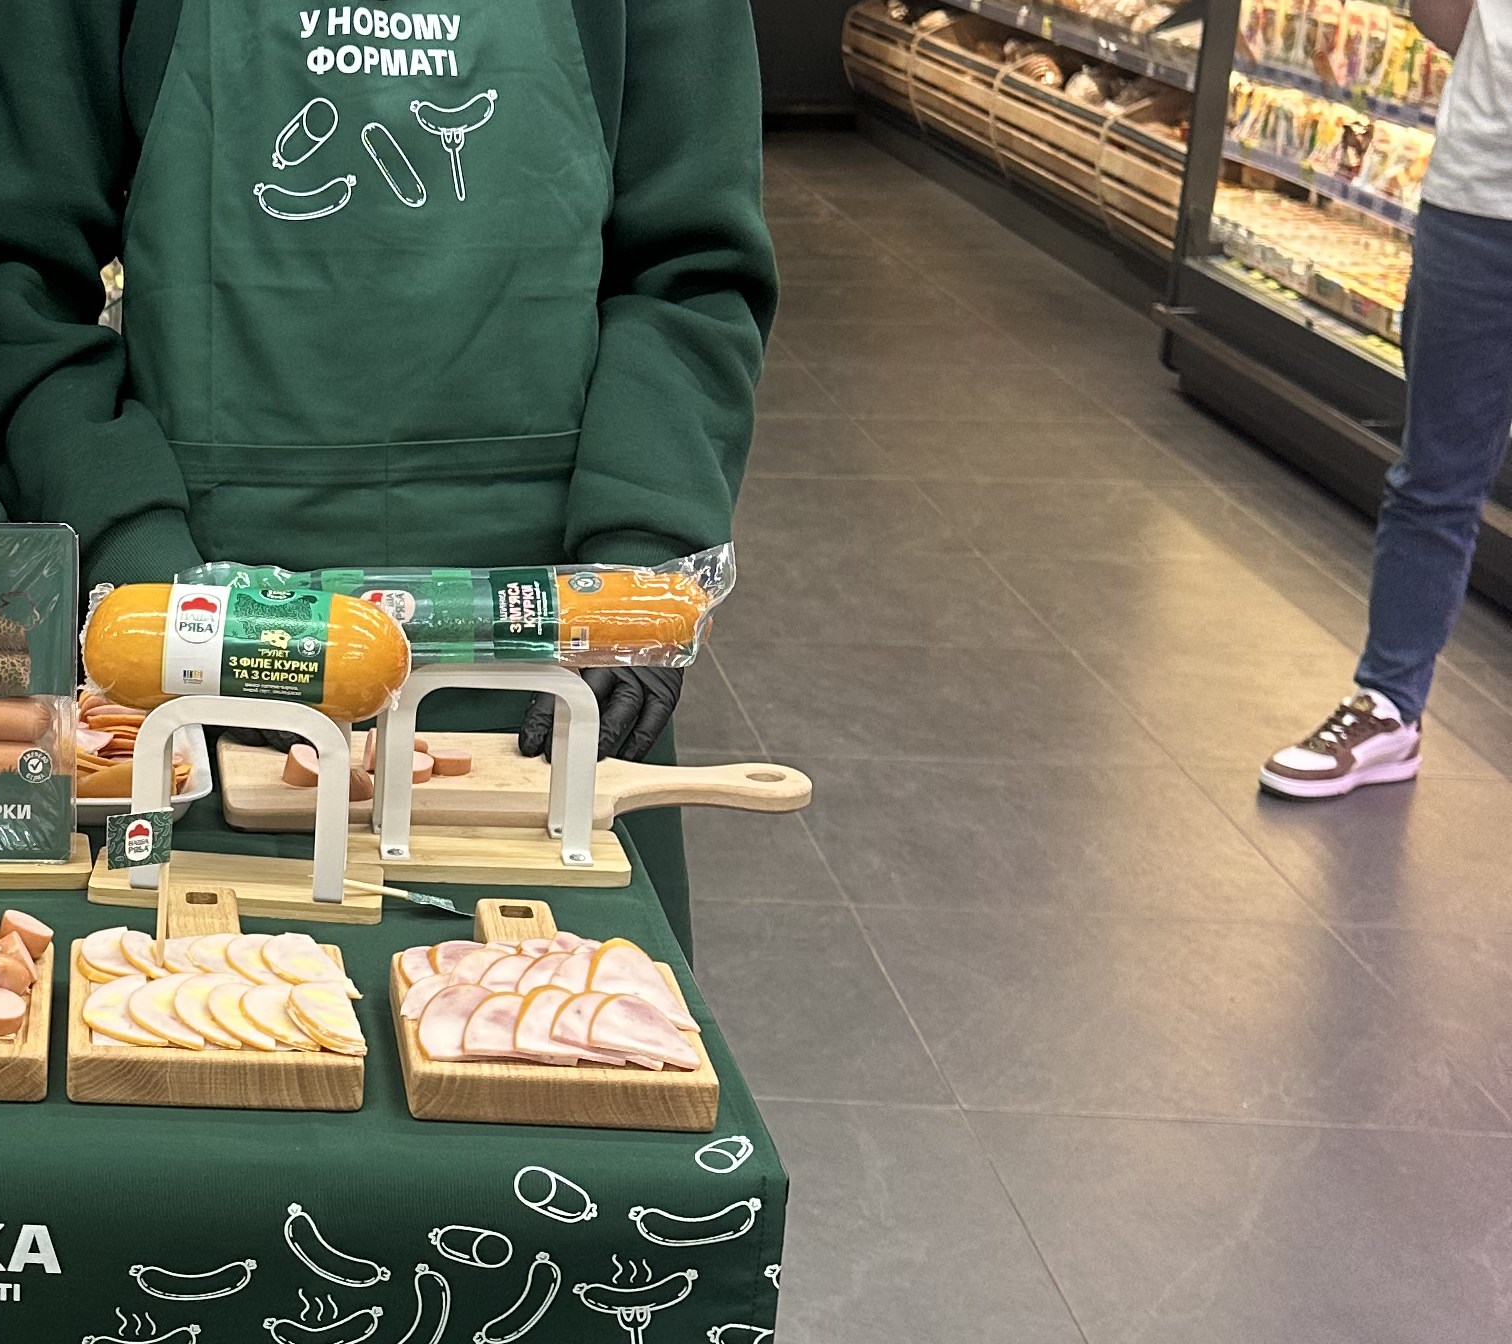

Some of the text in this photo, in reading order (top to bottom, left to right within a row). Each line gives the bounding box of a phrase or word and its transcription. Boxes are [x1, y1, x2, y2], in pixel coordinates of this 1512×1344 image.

[300, 6, 461, 41] У НОВОМУ
[306, 45, 458, 76] ФОРМАТІ
[507, 582, 521, 622] М'ЯСА
[521, 584, 536, 627] КУРКИ
[179, 623, 213, 633] РЯБА
[229, 657, 318, 673] З ФІЛЕ КУРКИ
[233, 669, 249, 678] ТА
[252, 670, 259, 679] З
